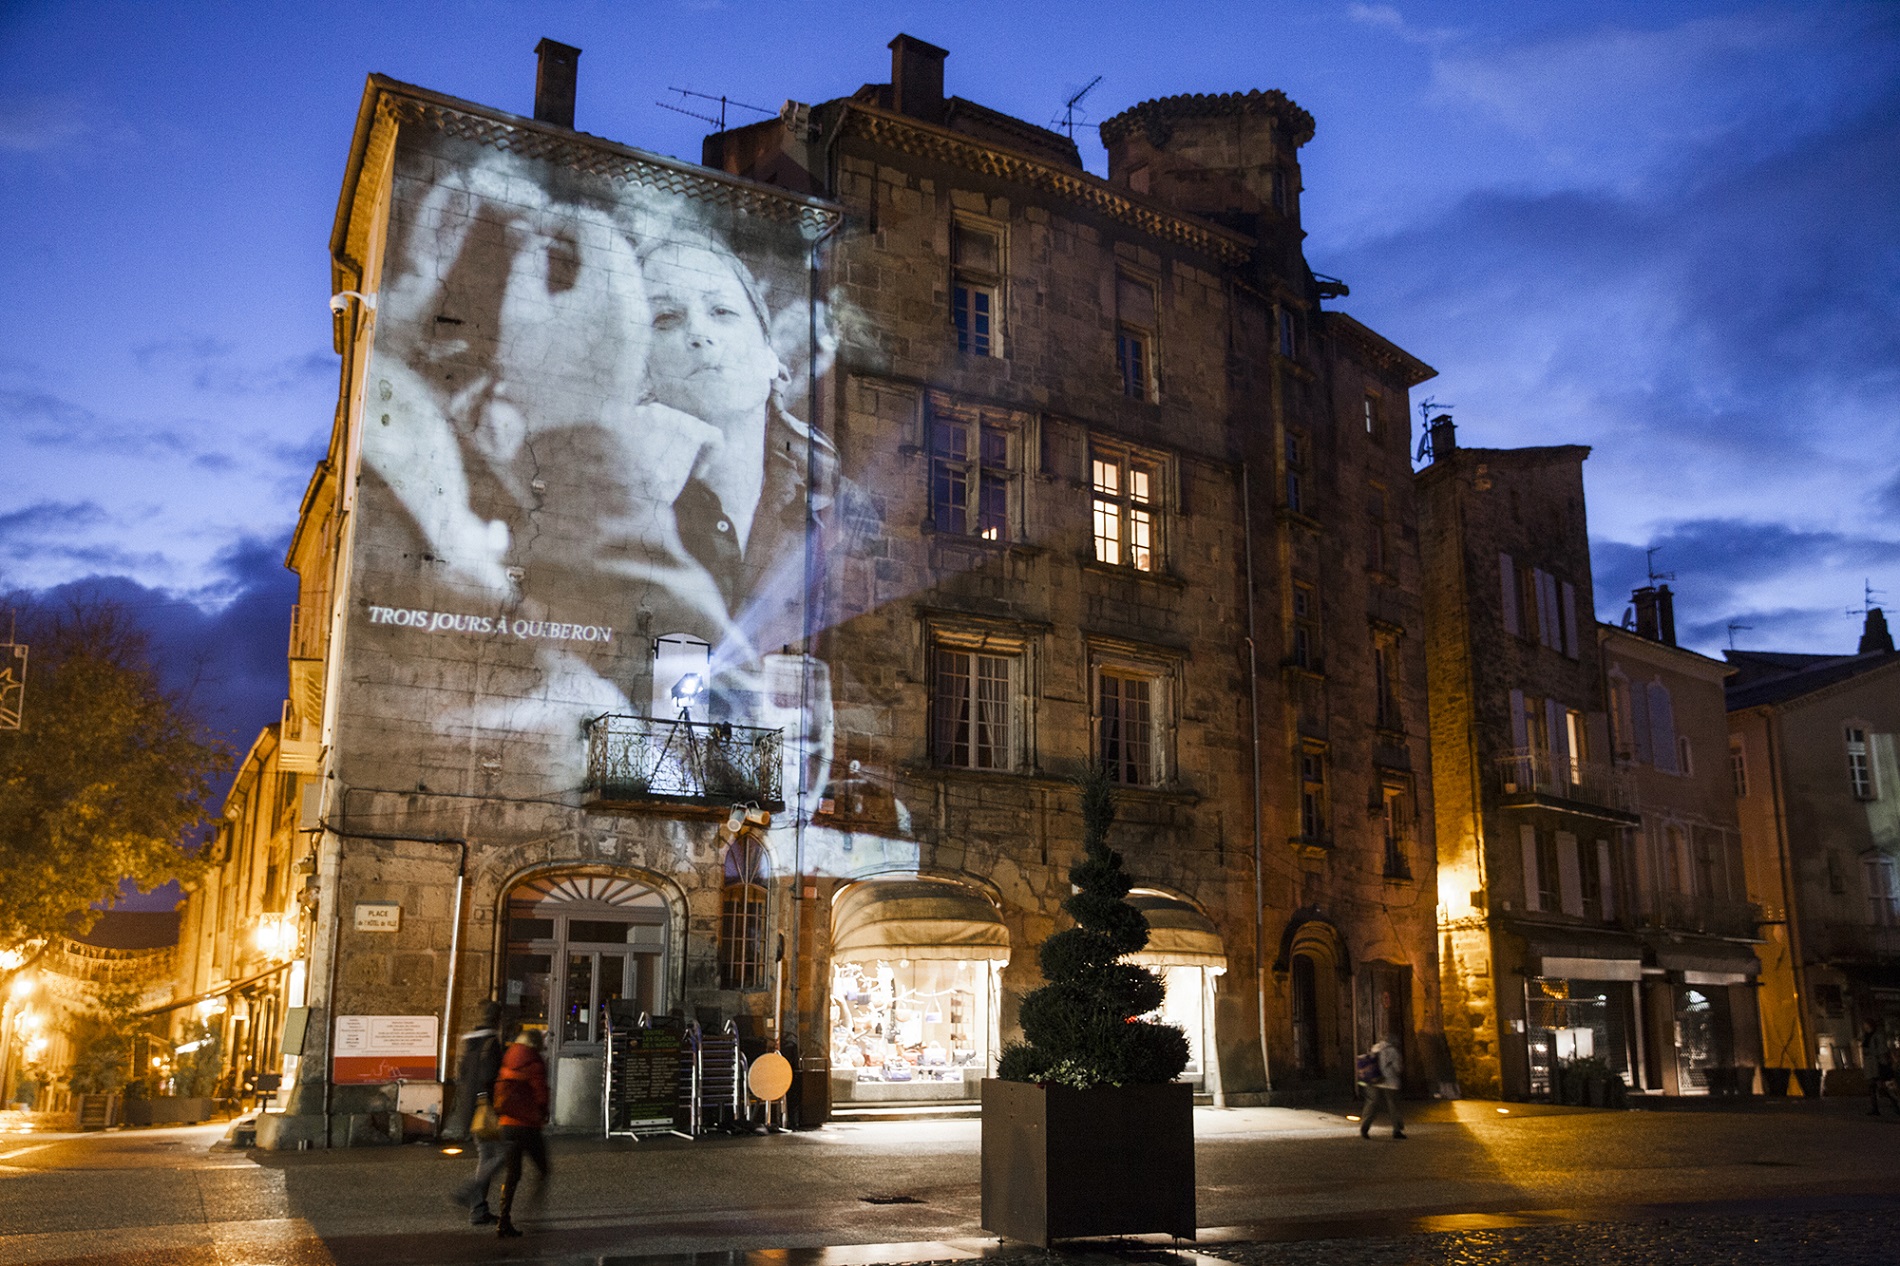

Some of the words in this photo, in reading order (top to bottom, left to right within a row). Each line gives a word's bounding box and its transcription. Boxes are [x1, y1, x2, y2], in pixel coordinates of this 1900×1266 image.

[368, 605, 427, 629] TROIS
[430, 612, 492, 633] JOURS
[512, 619, 612, 643] QUIBERON
